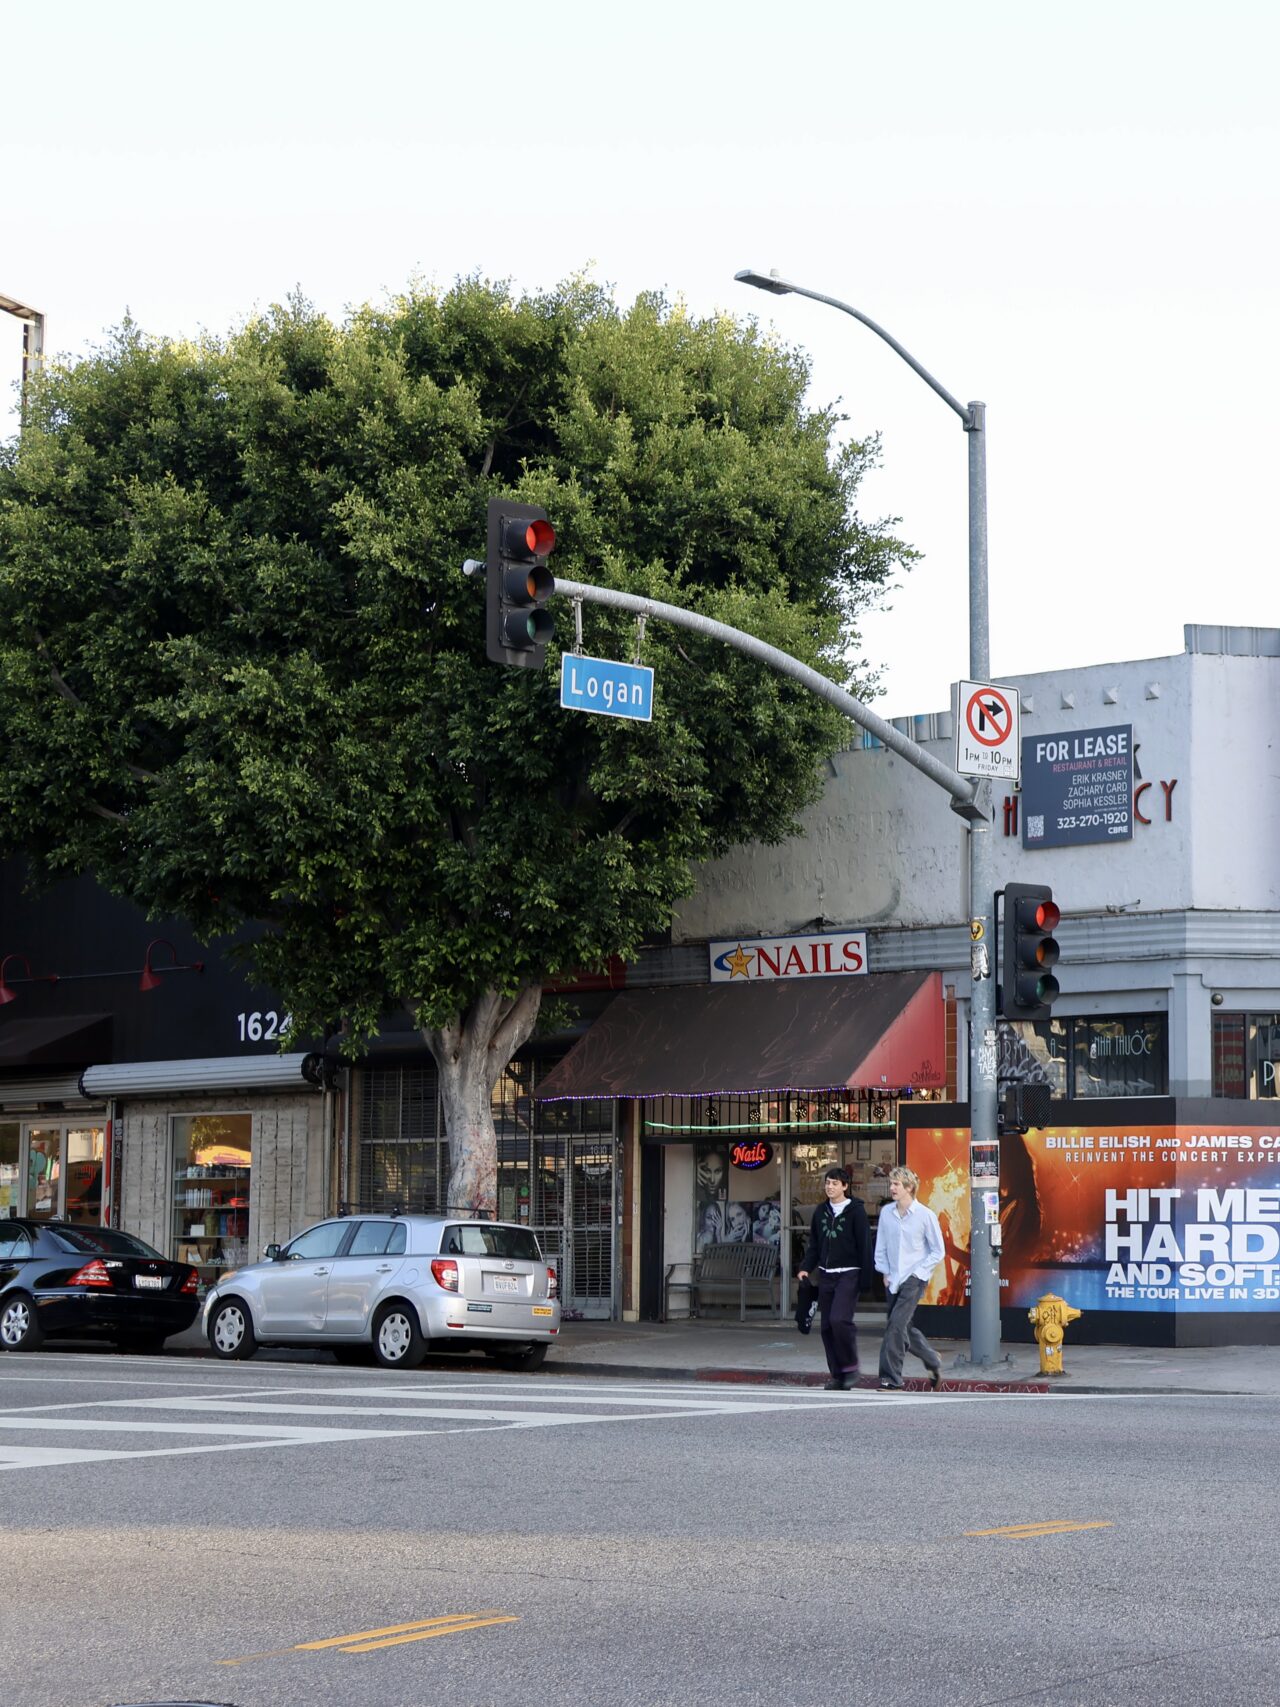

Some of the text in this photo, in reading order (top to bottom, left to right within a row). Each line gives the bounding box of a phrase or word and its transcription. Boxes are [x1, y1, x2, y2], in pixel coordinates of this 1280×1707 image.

[571, 667, 643, 709] Logan
[1036, 733, 1128, 763] FOR LEASE
[977, 763, 999, 772] FRIDAY
[1052, 756, 1127, 773] RESTAURANT & RETAIL
[1072, 769, 1127, 785] ERIK KRASNEY
[1068, 783, 1127, 798] ZACHARY CARD
[1063, 797, 1092, 810] SOPHIA
[1093, 794, 1127, 807] KESSLER
[1057, 811, 1128, 829] 323-270-1920
[1108, 825, 1128, 834] CBRE
[754, 941, 863, 977] NAILS
[1046, 1137, 1095, 1149] BILLIE
[1099, 1136, 1151, 1148] EILISH
[1155, 1139, 1181, 1148] AND
[1185, 1135, 1253, 1149] JAMES
[733, 1142, 766, 1164] Nails
[1065, 1151, 1125, 1163] REINVENT
[1133, 1151, 1154, 1162] THE
[1162, 1151, 1228, 1162] CONCERT
[1105, 1188, 1280, 1222] HIT ME
[1105, 1224, 1280, 1262] HARD
[1105, 1263, 1280, 1286] AND SOFT:
[1105, 1287, 1280, 1300] THE TOUR LIVE IN 3D
